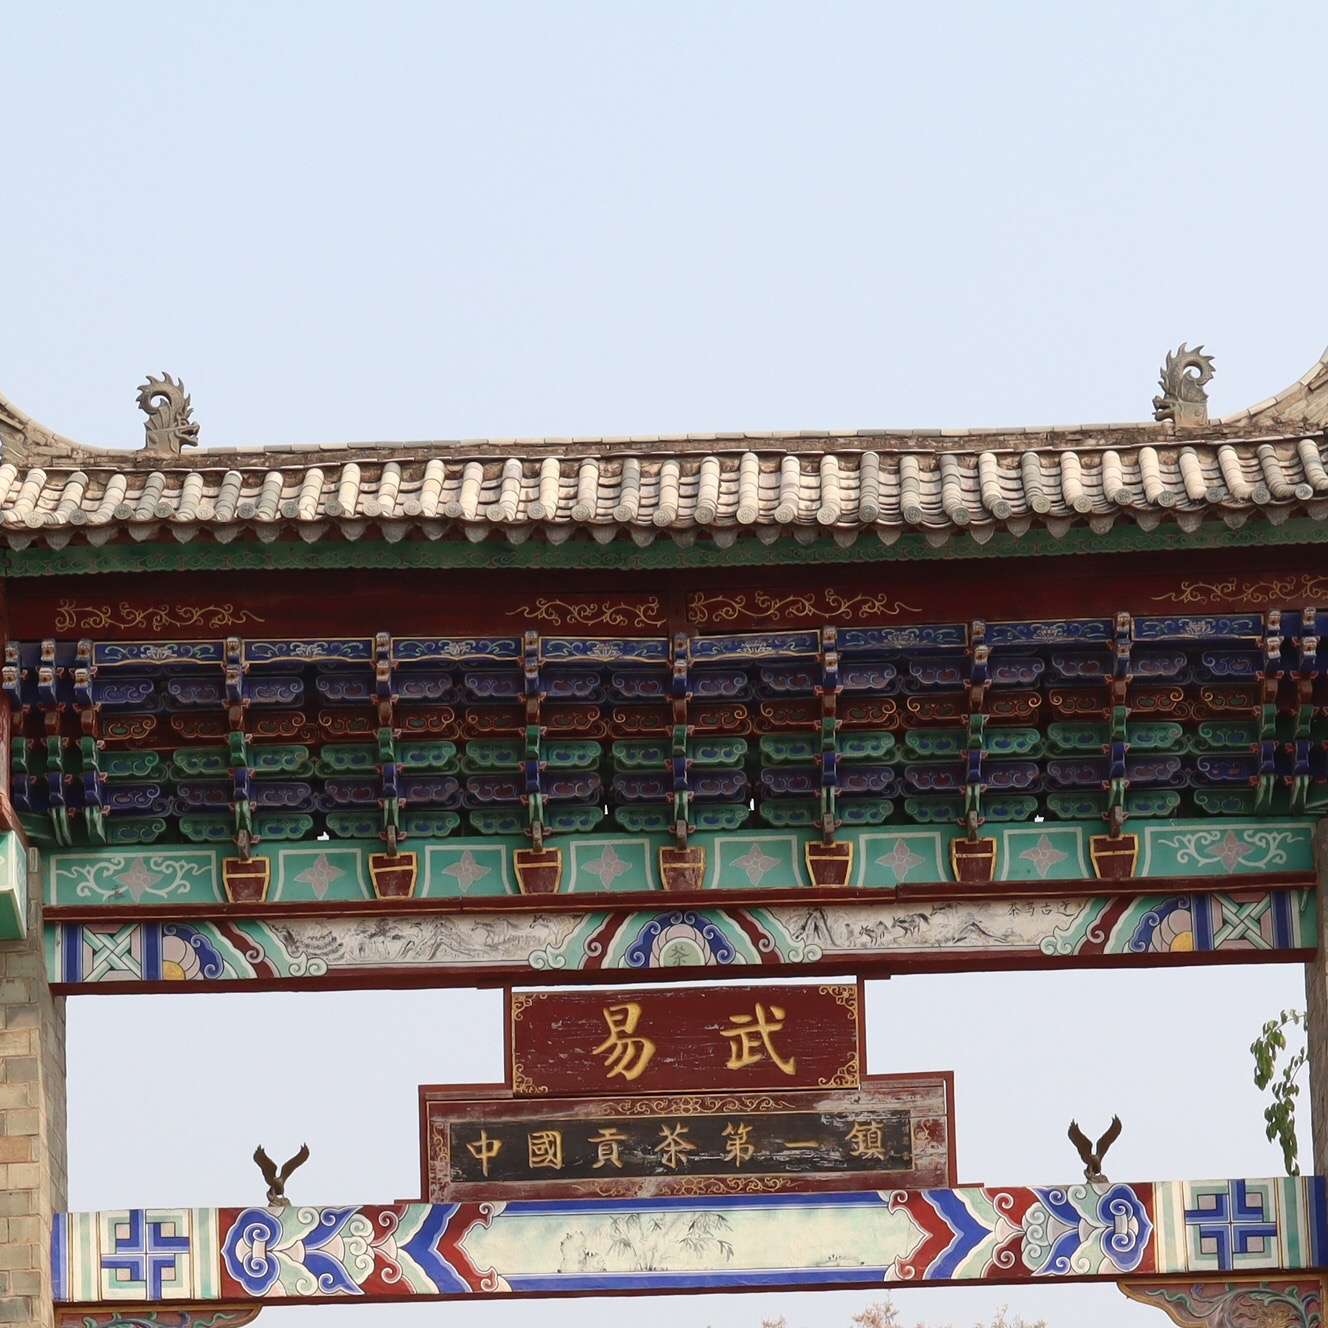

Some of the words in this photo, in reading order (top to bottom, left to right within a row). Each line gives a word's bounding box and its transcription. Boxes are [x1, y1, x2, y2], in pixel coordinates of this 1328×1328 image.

[592, 1002, 796, 1081] 易武
[466, 1119, 886, 1177] 中國貢茶第一鎮
